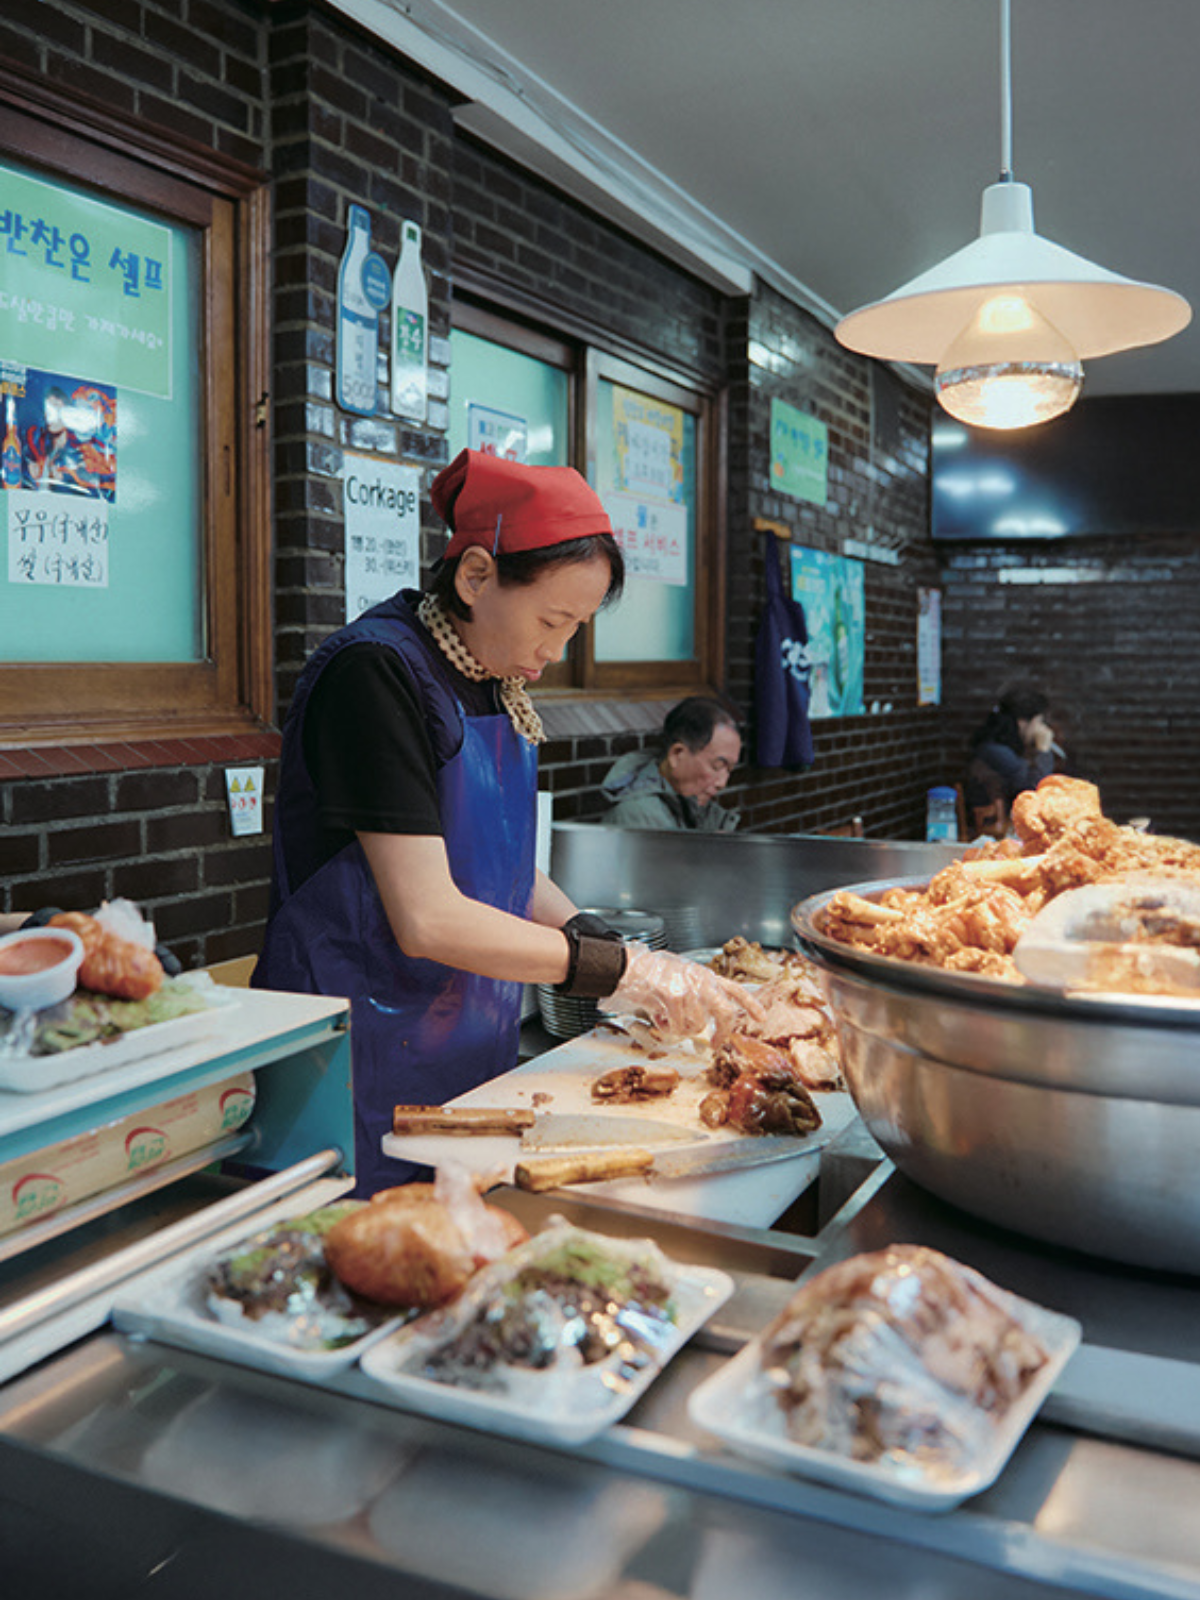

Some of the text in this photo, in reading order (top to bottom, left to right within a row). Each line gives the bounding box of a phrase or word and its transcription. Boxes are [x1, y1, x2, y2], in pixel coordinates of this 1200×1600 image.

[0, 209, 163, 298] 반찬은 셀프
[346, 475, 415, 517] Corkage
